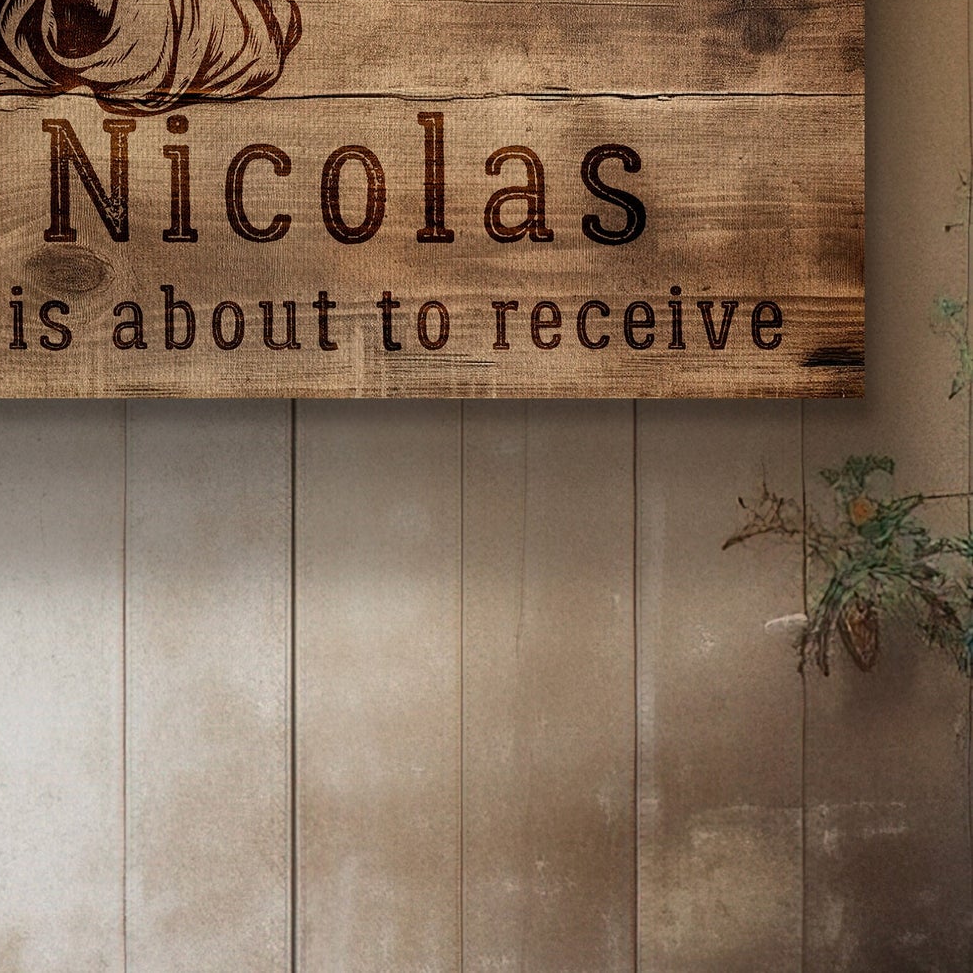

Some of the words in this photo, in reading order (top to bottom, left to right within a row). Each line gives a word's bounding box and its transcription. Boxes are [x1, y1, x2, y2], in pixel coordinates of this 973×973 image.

[42, 112, 646, 246] Nicolas
[11, 286, 74, 351] is
[113, 284, 340, 351] about
[378, 289, 453, 351] to
[492, 285, 785, 351] receive
